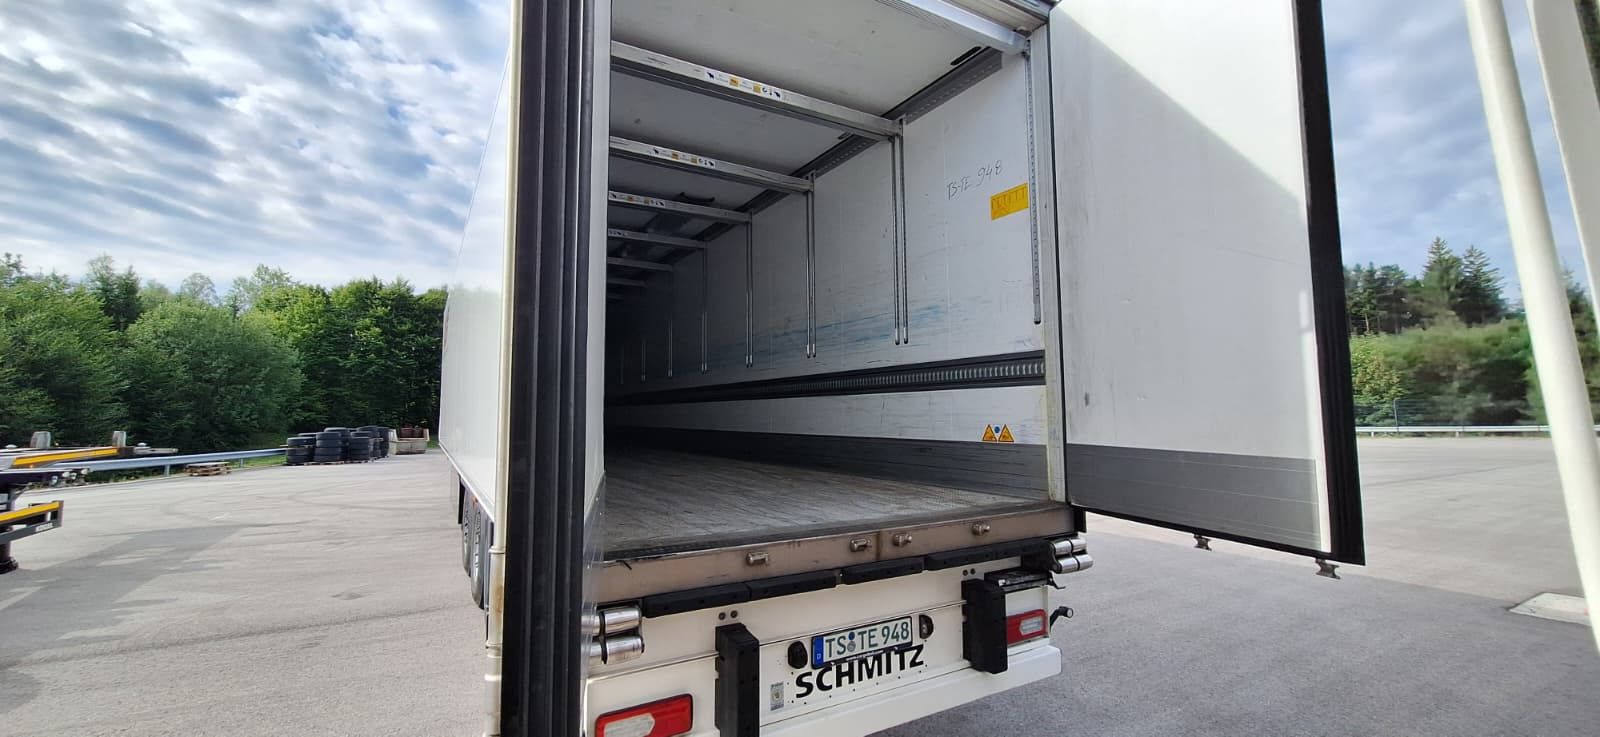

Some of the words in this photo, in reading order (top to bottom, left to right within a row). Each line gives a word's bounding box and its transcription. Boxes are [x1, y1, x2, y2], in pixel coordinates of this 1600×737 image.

[976, 159, 1002, 187] 948
[825, 635, 847, 658] TS
[858, 629, 877, 649] TE
[881, 622, 909, 644] 948
[795, 643, 924, 699] SCHMITZ
